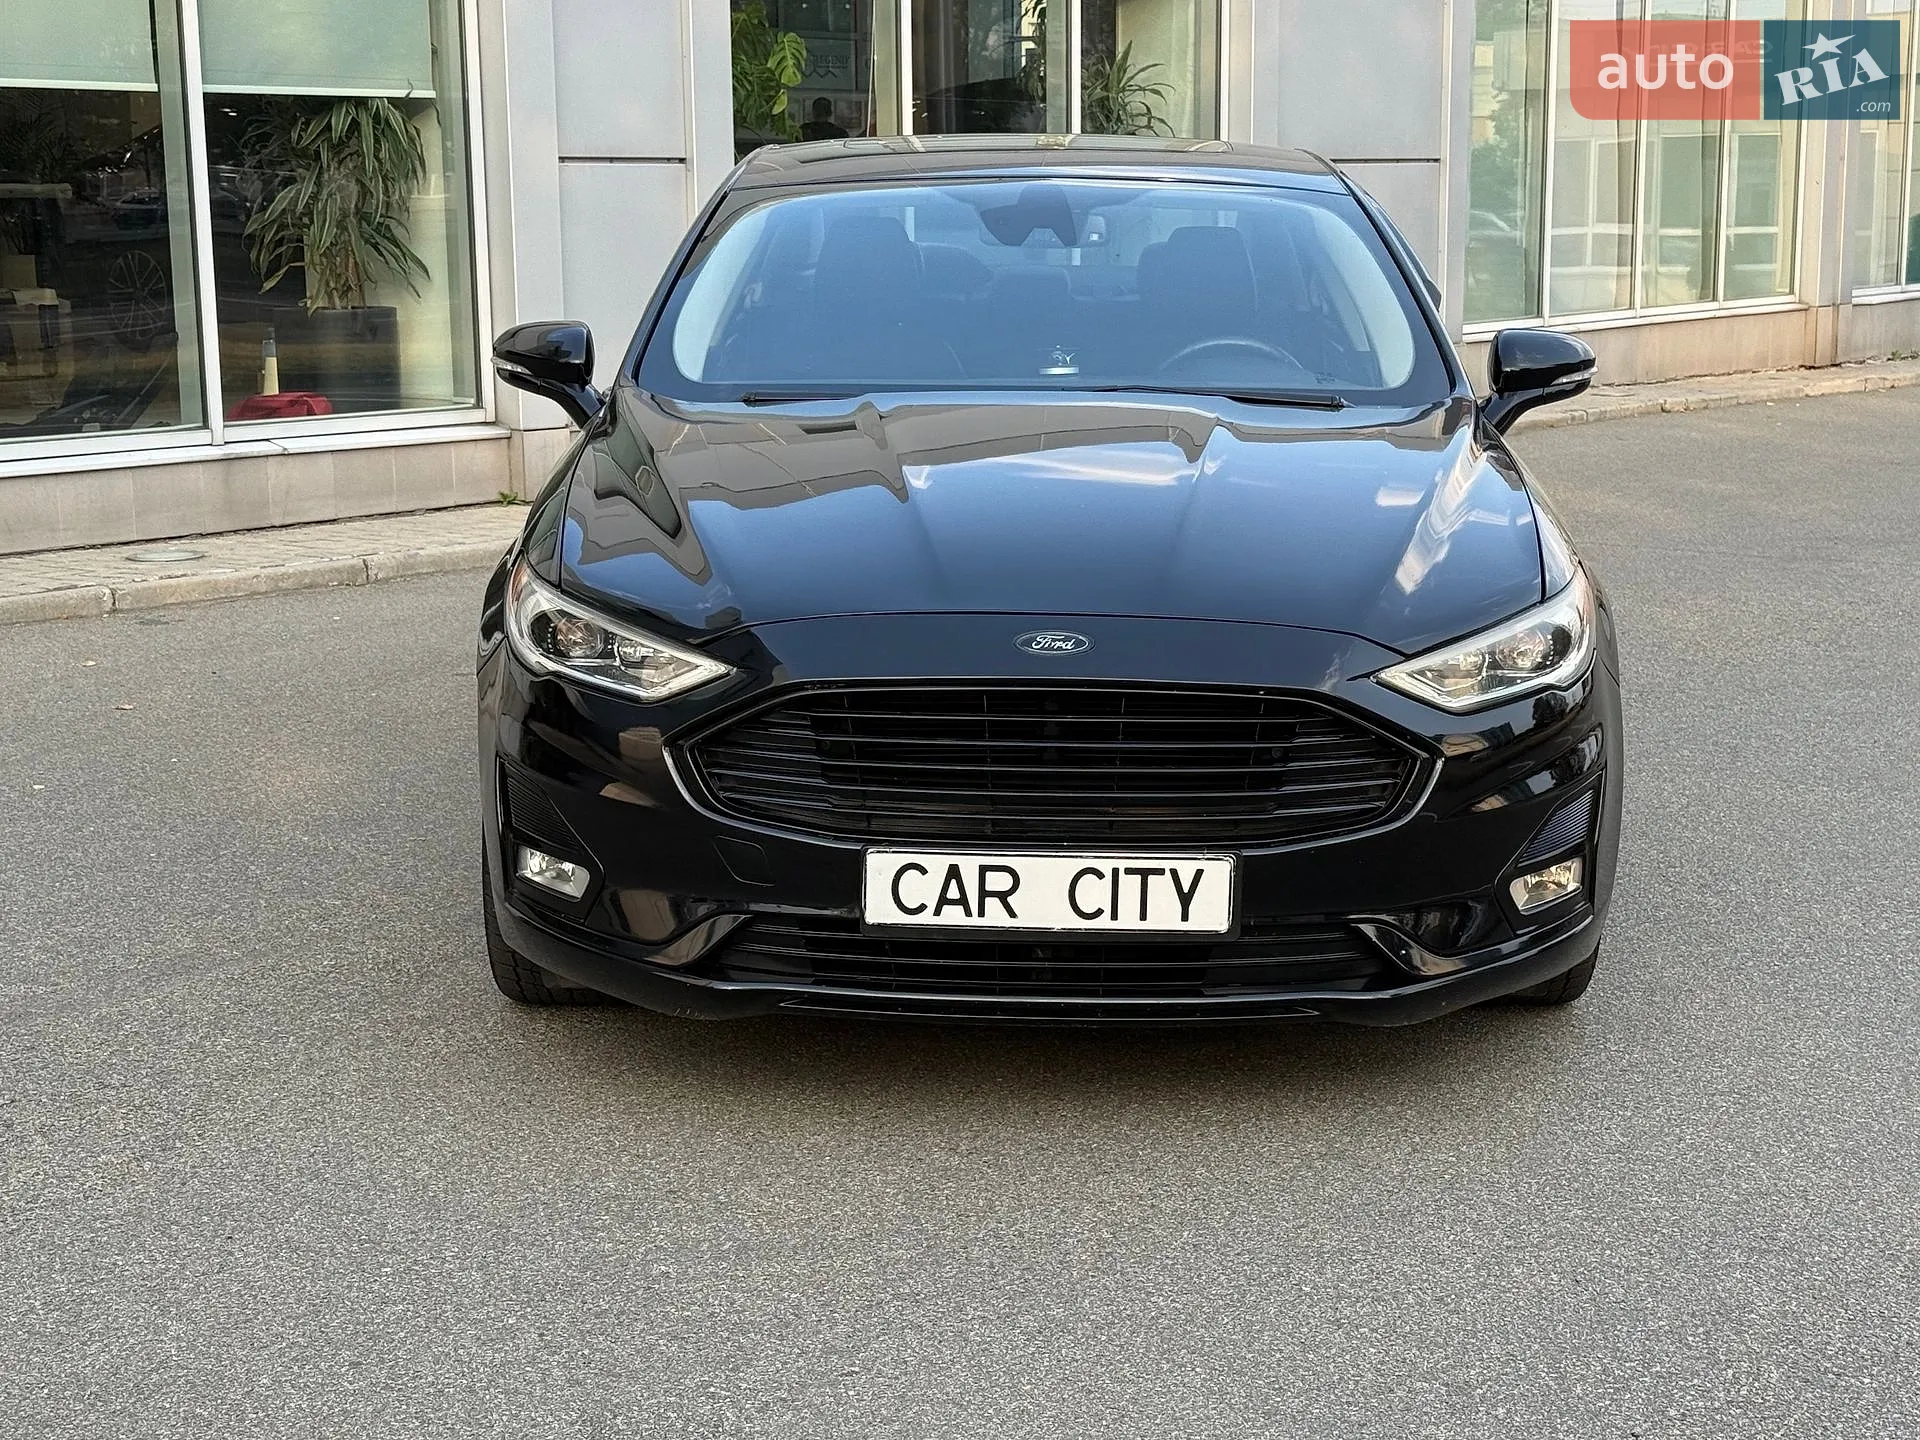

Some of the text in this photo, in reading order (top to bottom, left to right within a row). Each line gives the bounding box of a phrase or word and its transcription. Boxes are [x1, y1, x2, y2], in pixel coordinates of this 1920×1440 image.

[1031, 634, 1076, 650] Ford
[891, 862, 1205, 922] CAR CITY
